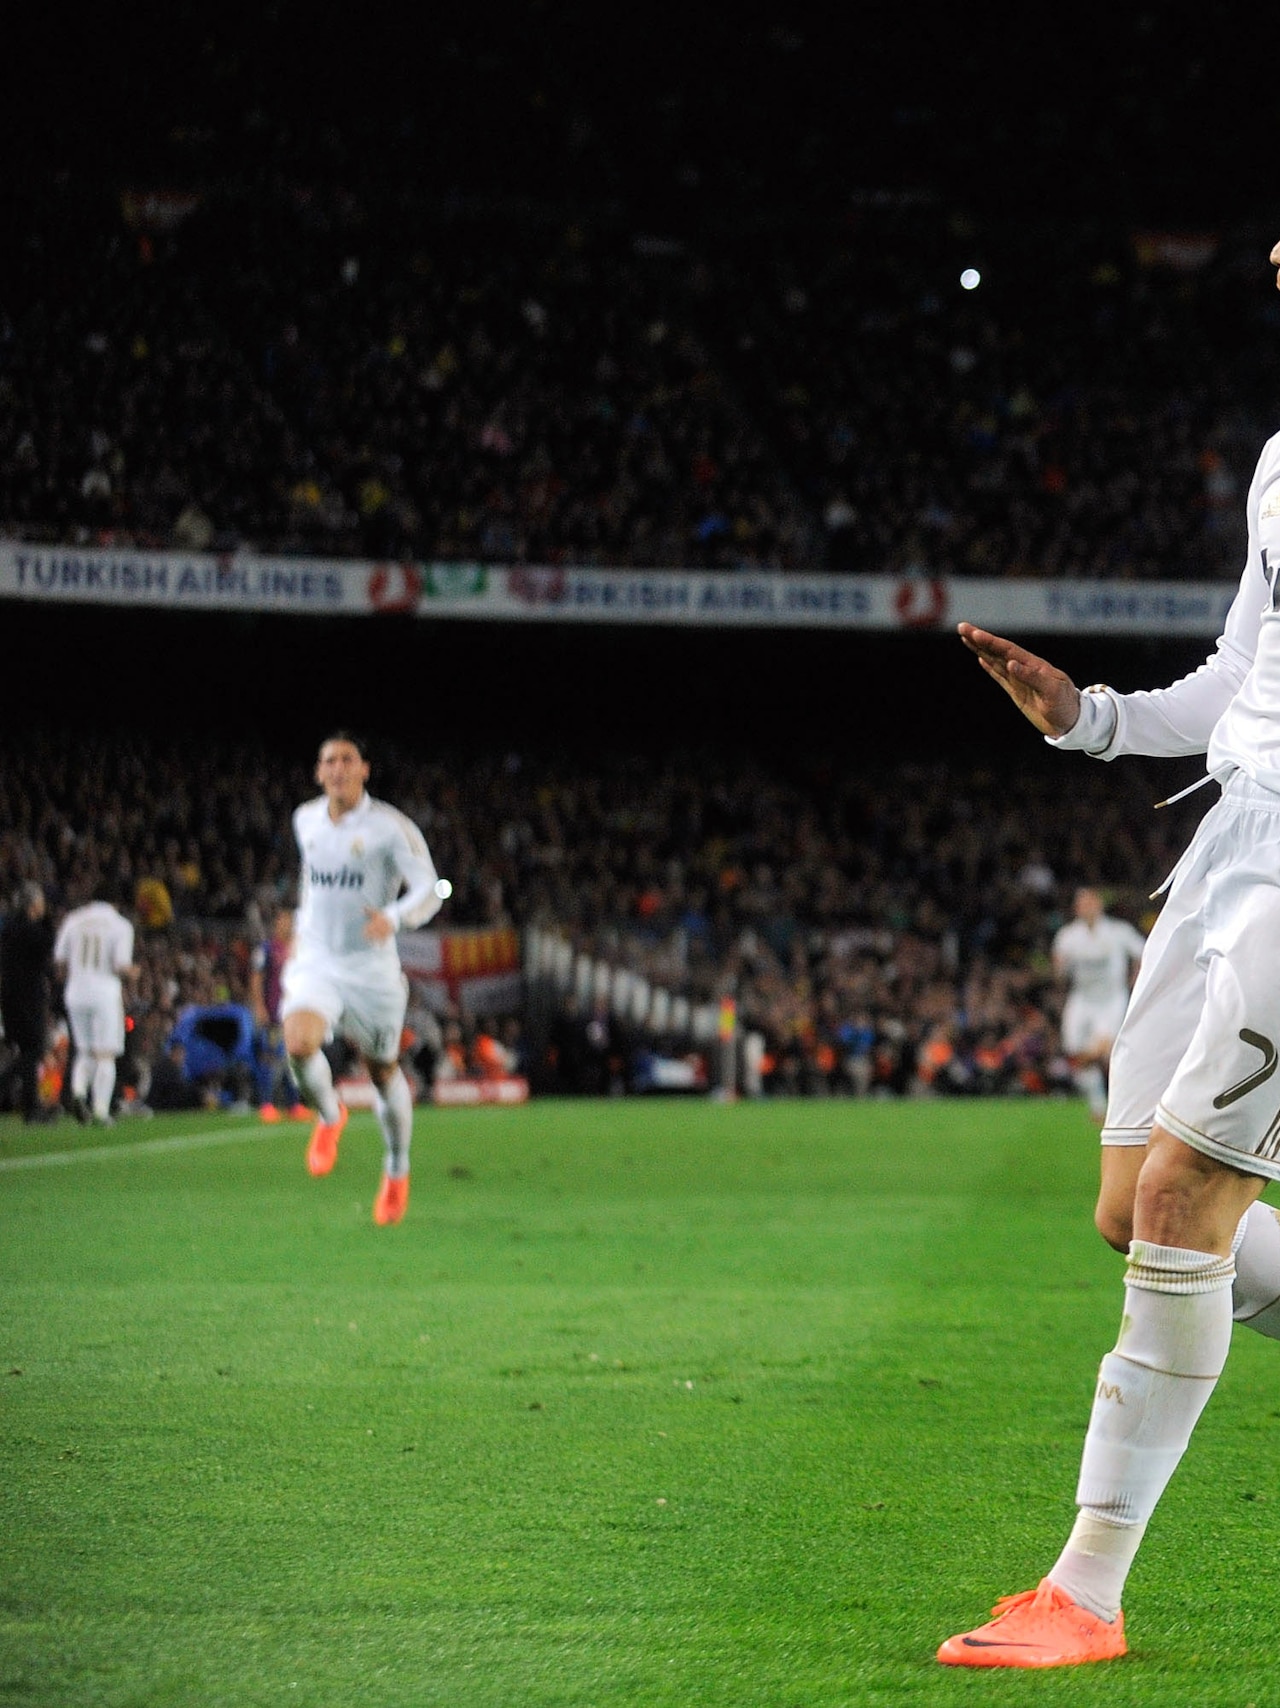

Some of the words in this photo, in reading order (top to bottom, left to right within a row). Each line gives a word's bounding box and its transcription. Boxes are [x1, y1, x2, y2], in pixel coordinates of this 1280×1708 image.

[14, 553, 168, 592] TURKISH
[177, 562, 344, 604] AIRLINES
[698, 579, 873, 614] AIRLINES
[311, 865, 365, 890] bwin
[81, 932, 102, 971] 11
[1212, 1028, 1279, 1110] 7
